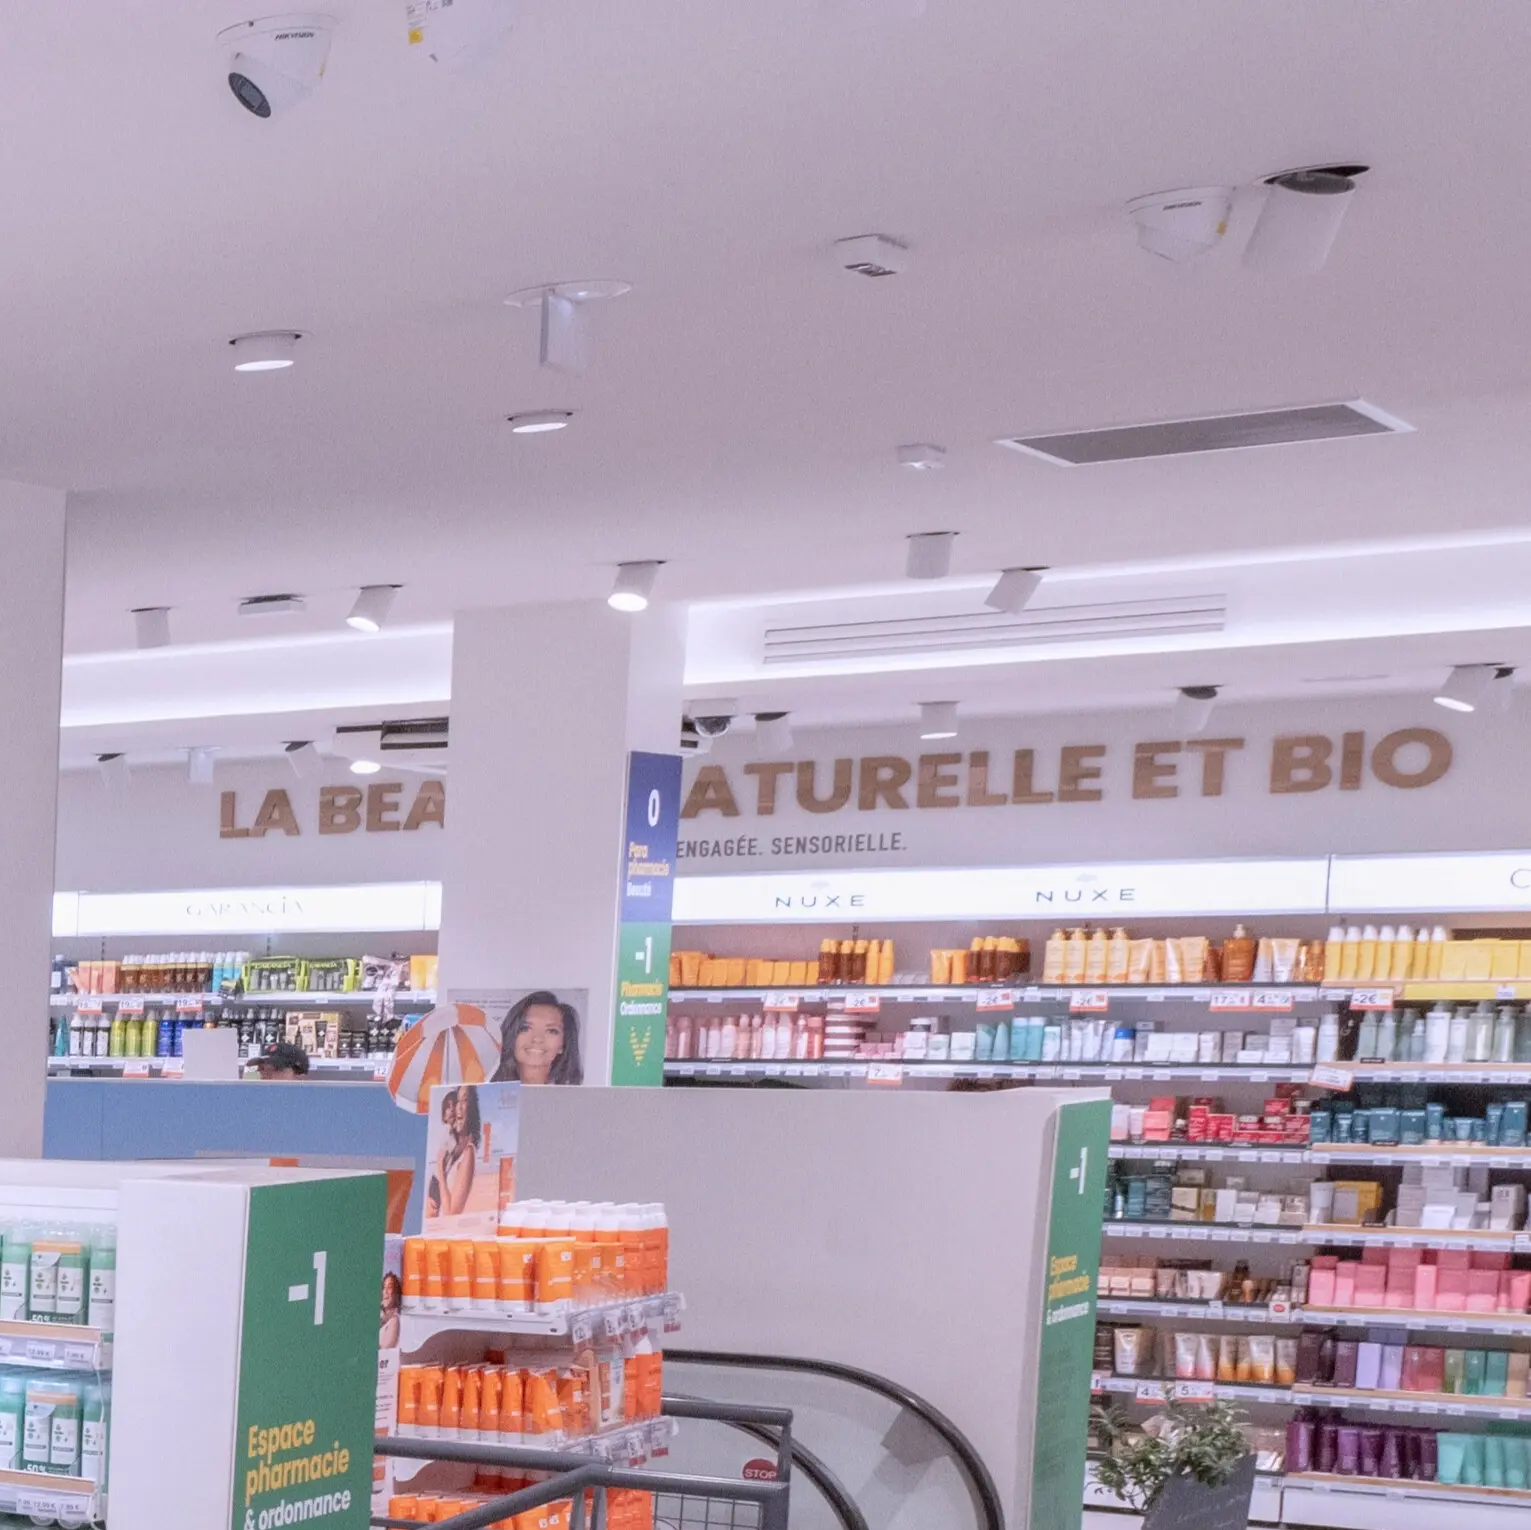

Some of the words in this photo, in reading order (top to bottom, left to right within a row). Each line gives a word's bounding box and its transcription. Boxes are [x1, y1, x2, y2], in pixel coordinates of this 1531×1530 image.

[219, 789, 300, 839] LA
[318, 780, 445, 834] BEA
[681, 744, 1106, 818] ATURELLE
[1133, 737, 1245, 799] ET
[1269, 728, 1453, 794] BIO
[648, 788, 660, 828] 0
[771, 831, 908, 857] SENSORIELLE.
[774, 893, 866, 908] NUXE
[1035, 888, 1136, 902] NUXE
[248, 1418, 316, 1461] Espace
[245, 1441, 350, 1505] pharmacie
[744, 1468, 777, 1480] STOP
[258, 1487, 352, 1529] ordonnance
